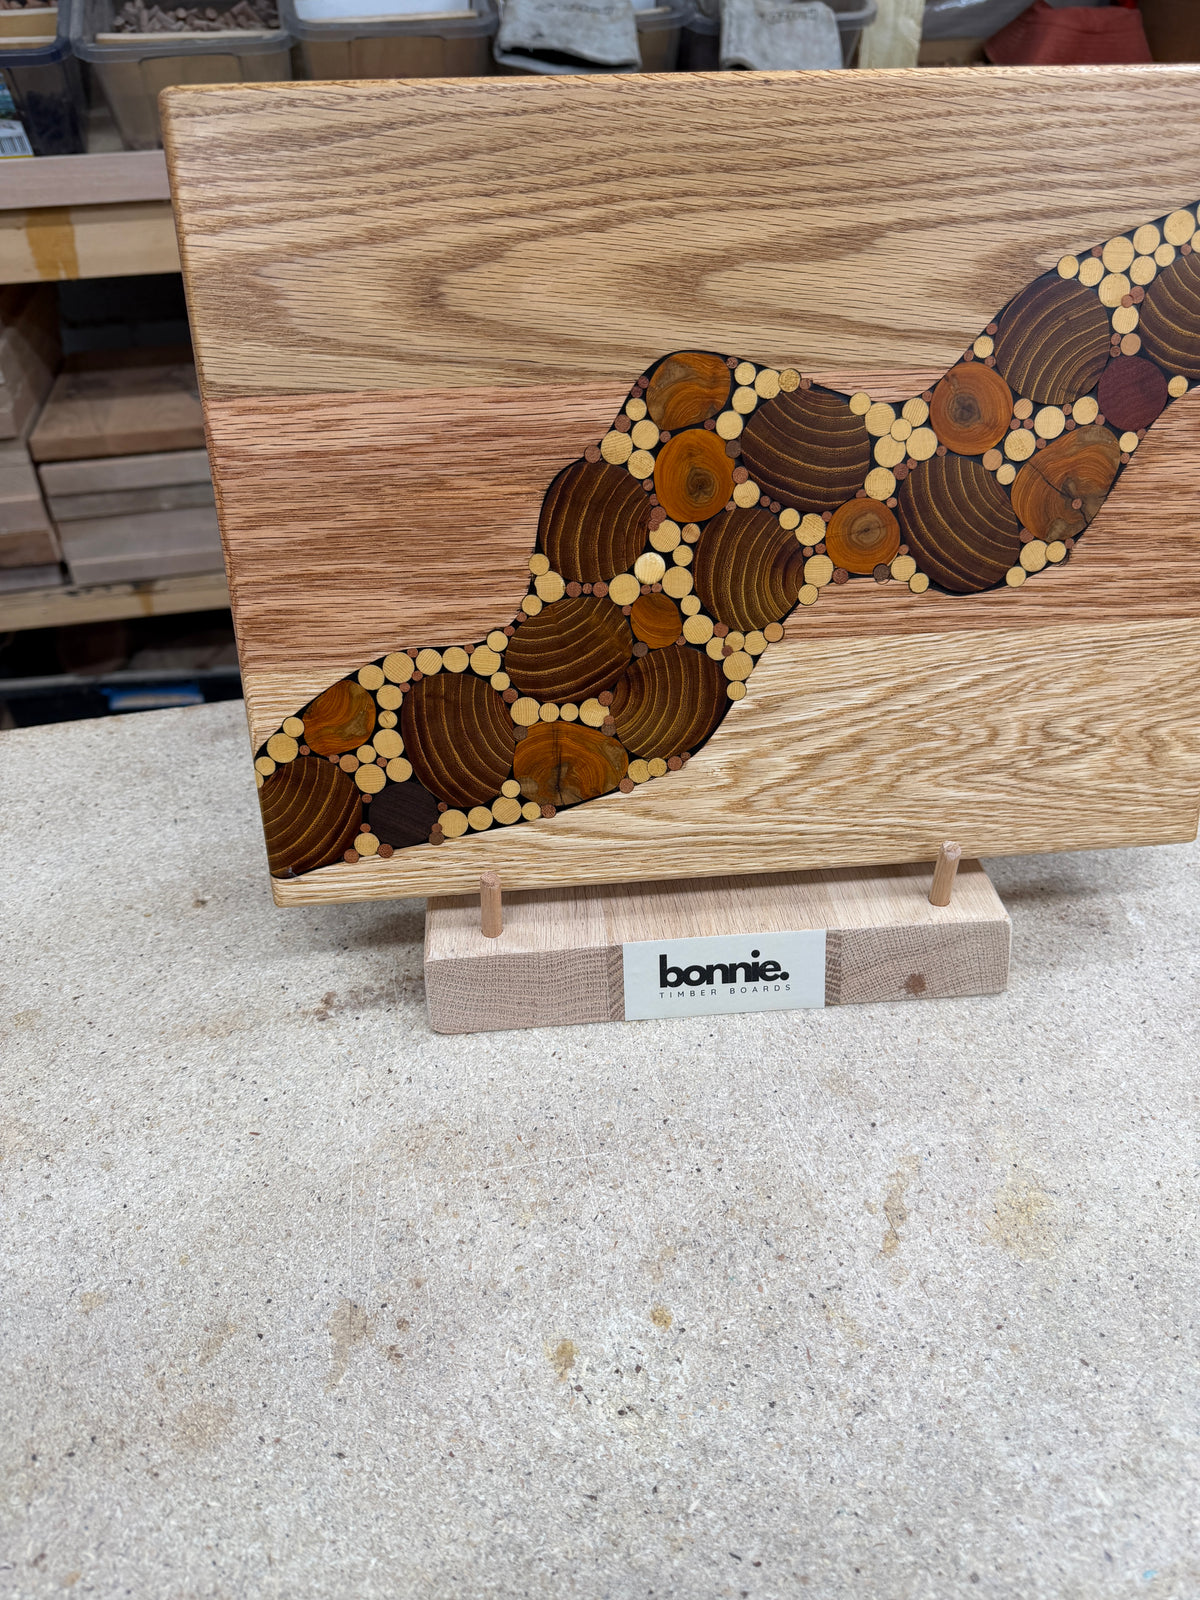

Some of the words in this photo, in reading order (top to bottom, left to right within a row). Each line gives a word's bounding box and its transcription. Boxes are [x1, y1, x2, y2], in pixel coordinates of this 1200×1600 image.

[659, 949, 790, 988] bonnie.
[659, 988, 718, 999] TIMBER
[729, 984, 791, 995] BOARDS
